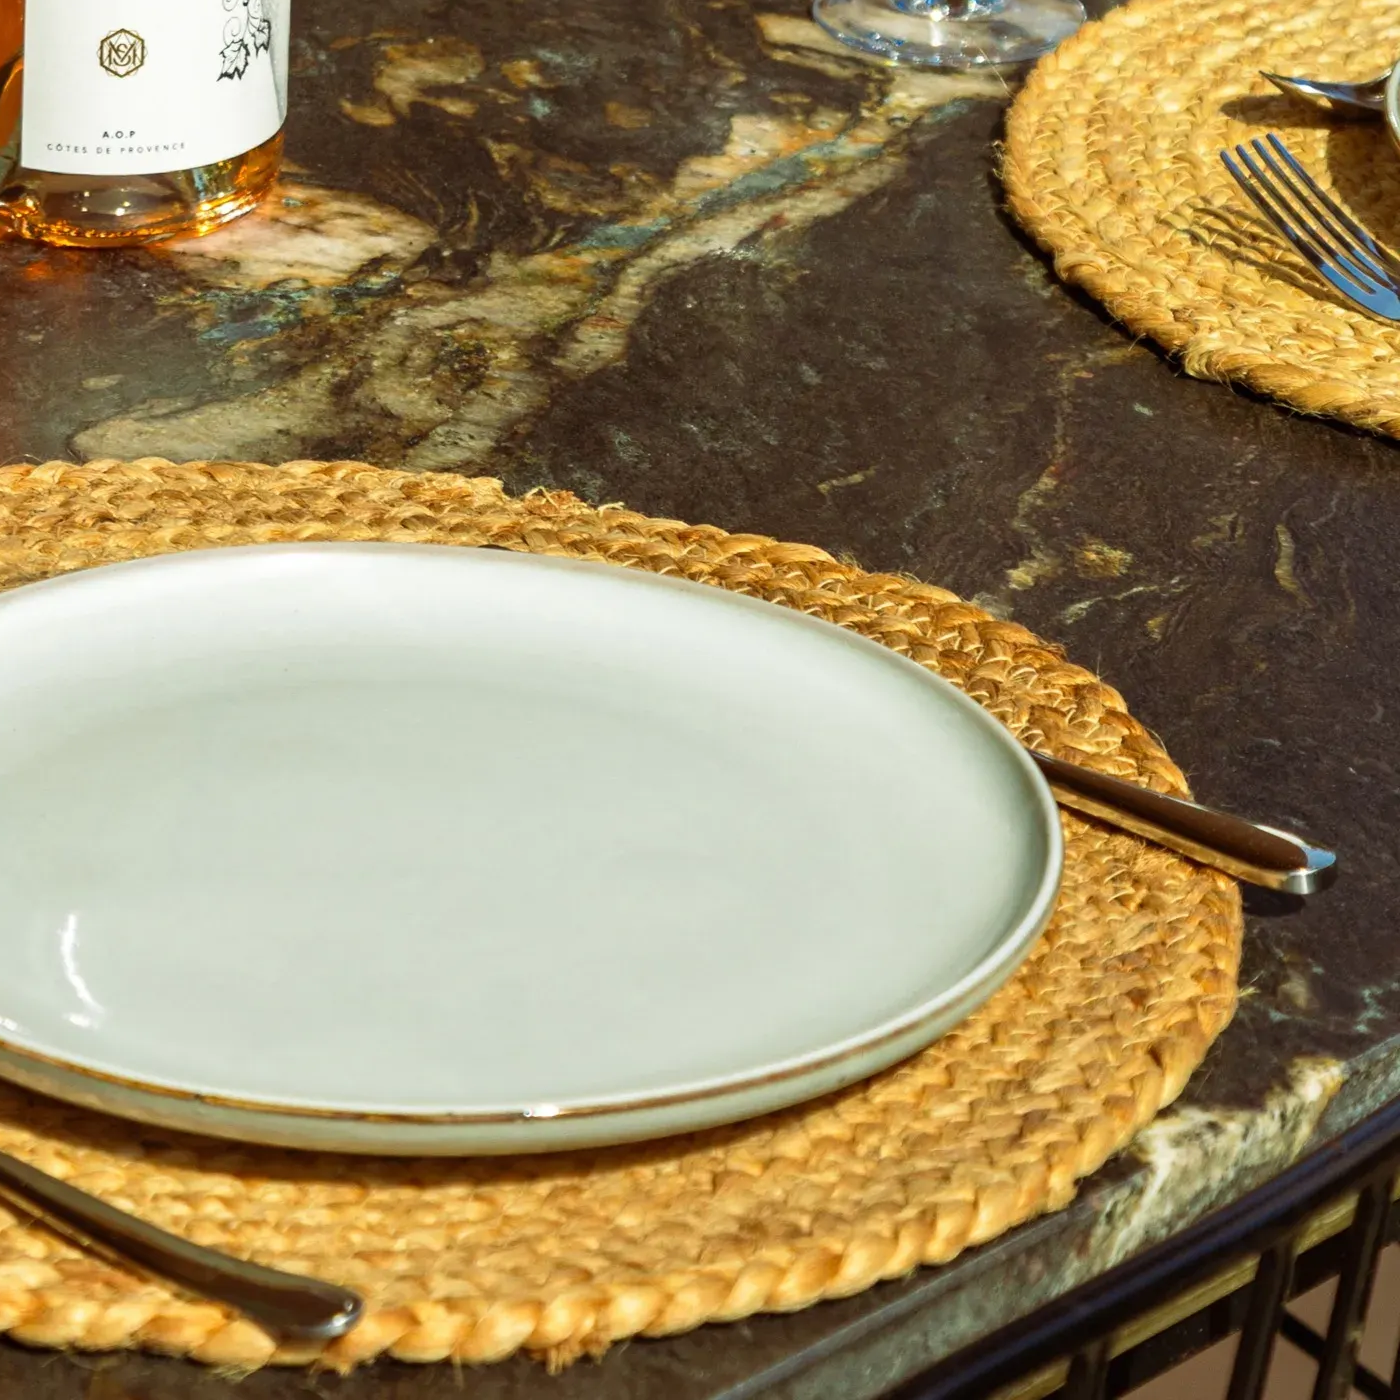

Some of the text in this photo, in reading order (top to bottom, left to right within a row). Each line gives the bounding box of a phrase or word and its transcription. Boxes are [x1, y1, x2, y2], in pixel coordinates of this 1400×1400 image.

[102, 130, 136, 139] A.O.P
[96, 146, 111, 155] DE
[120, 142, 185, 154] PROVENCE
